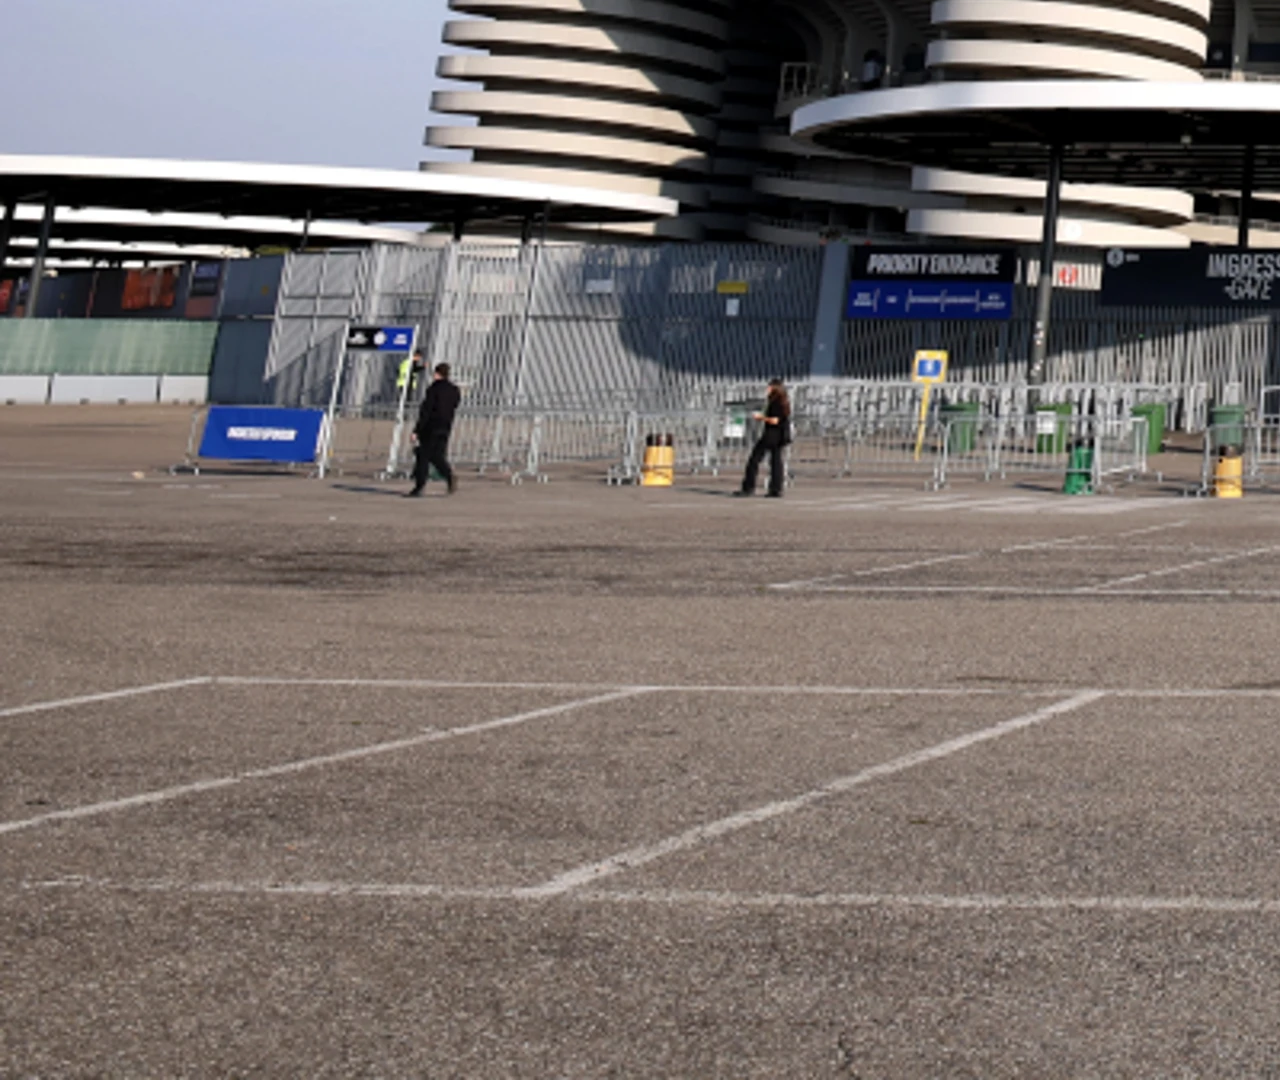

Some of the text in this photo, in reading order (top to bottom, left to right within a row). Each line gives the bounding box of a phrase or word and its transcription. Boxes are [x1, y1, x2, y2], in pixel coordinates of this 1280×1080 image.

[867, 253, 1000, 274] PRIORITY ENTRANCE
[1229, 279, 1272, 301] GATE
